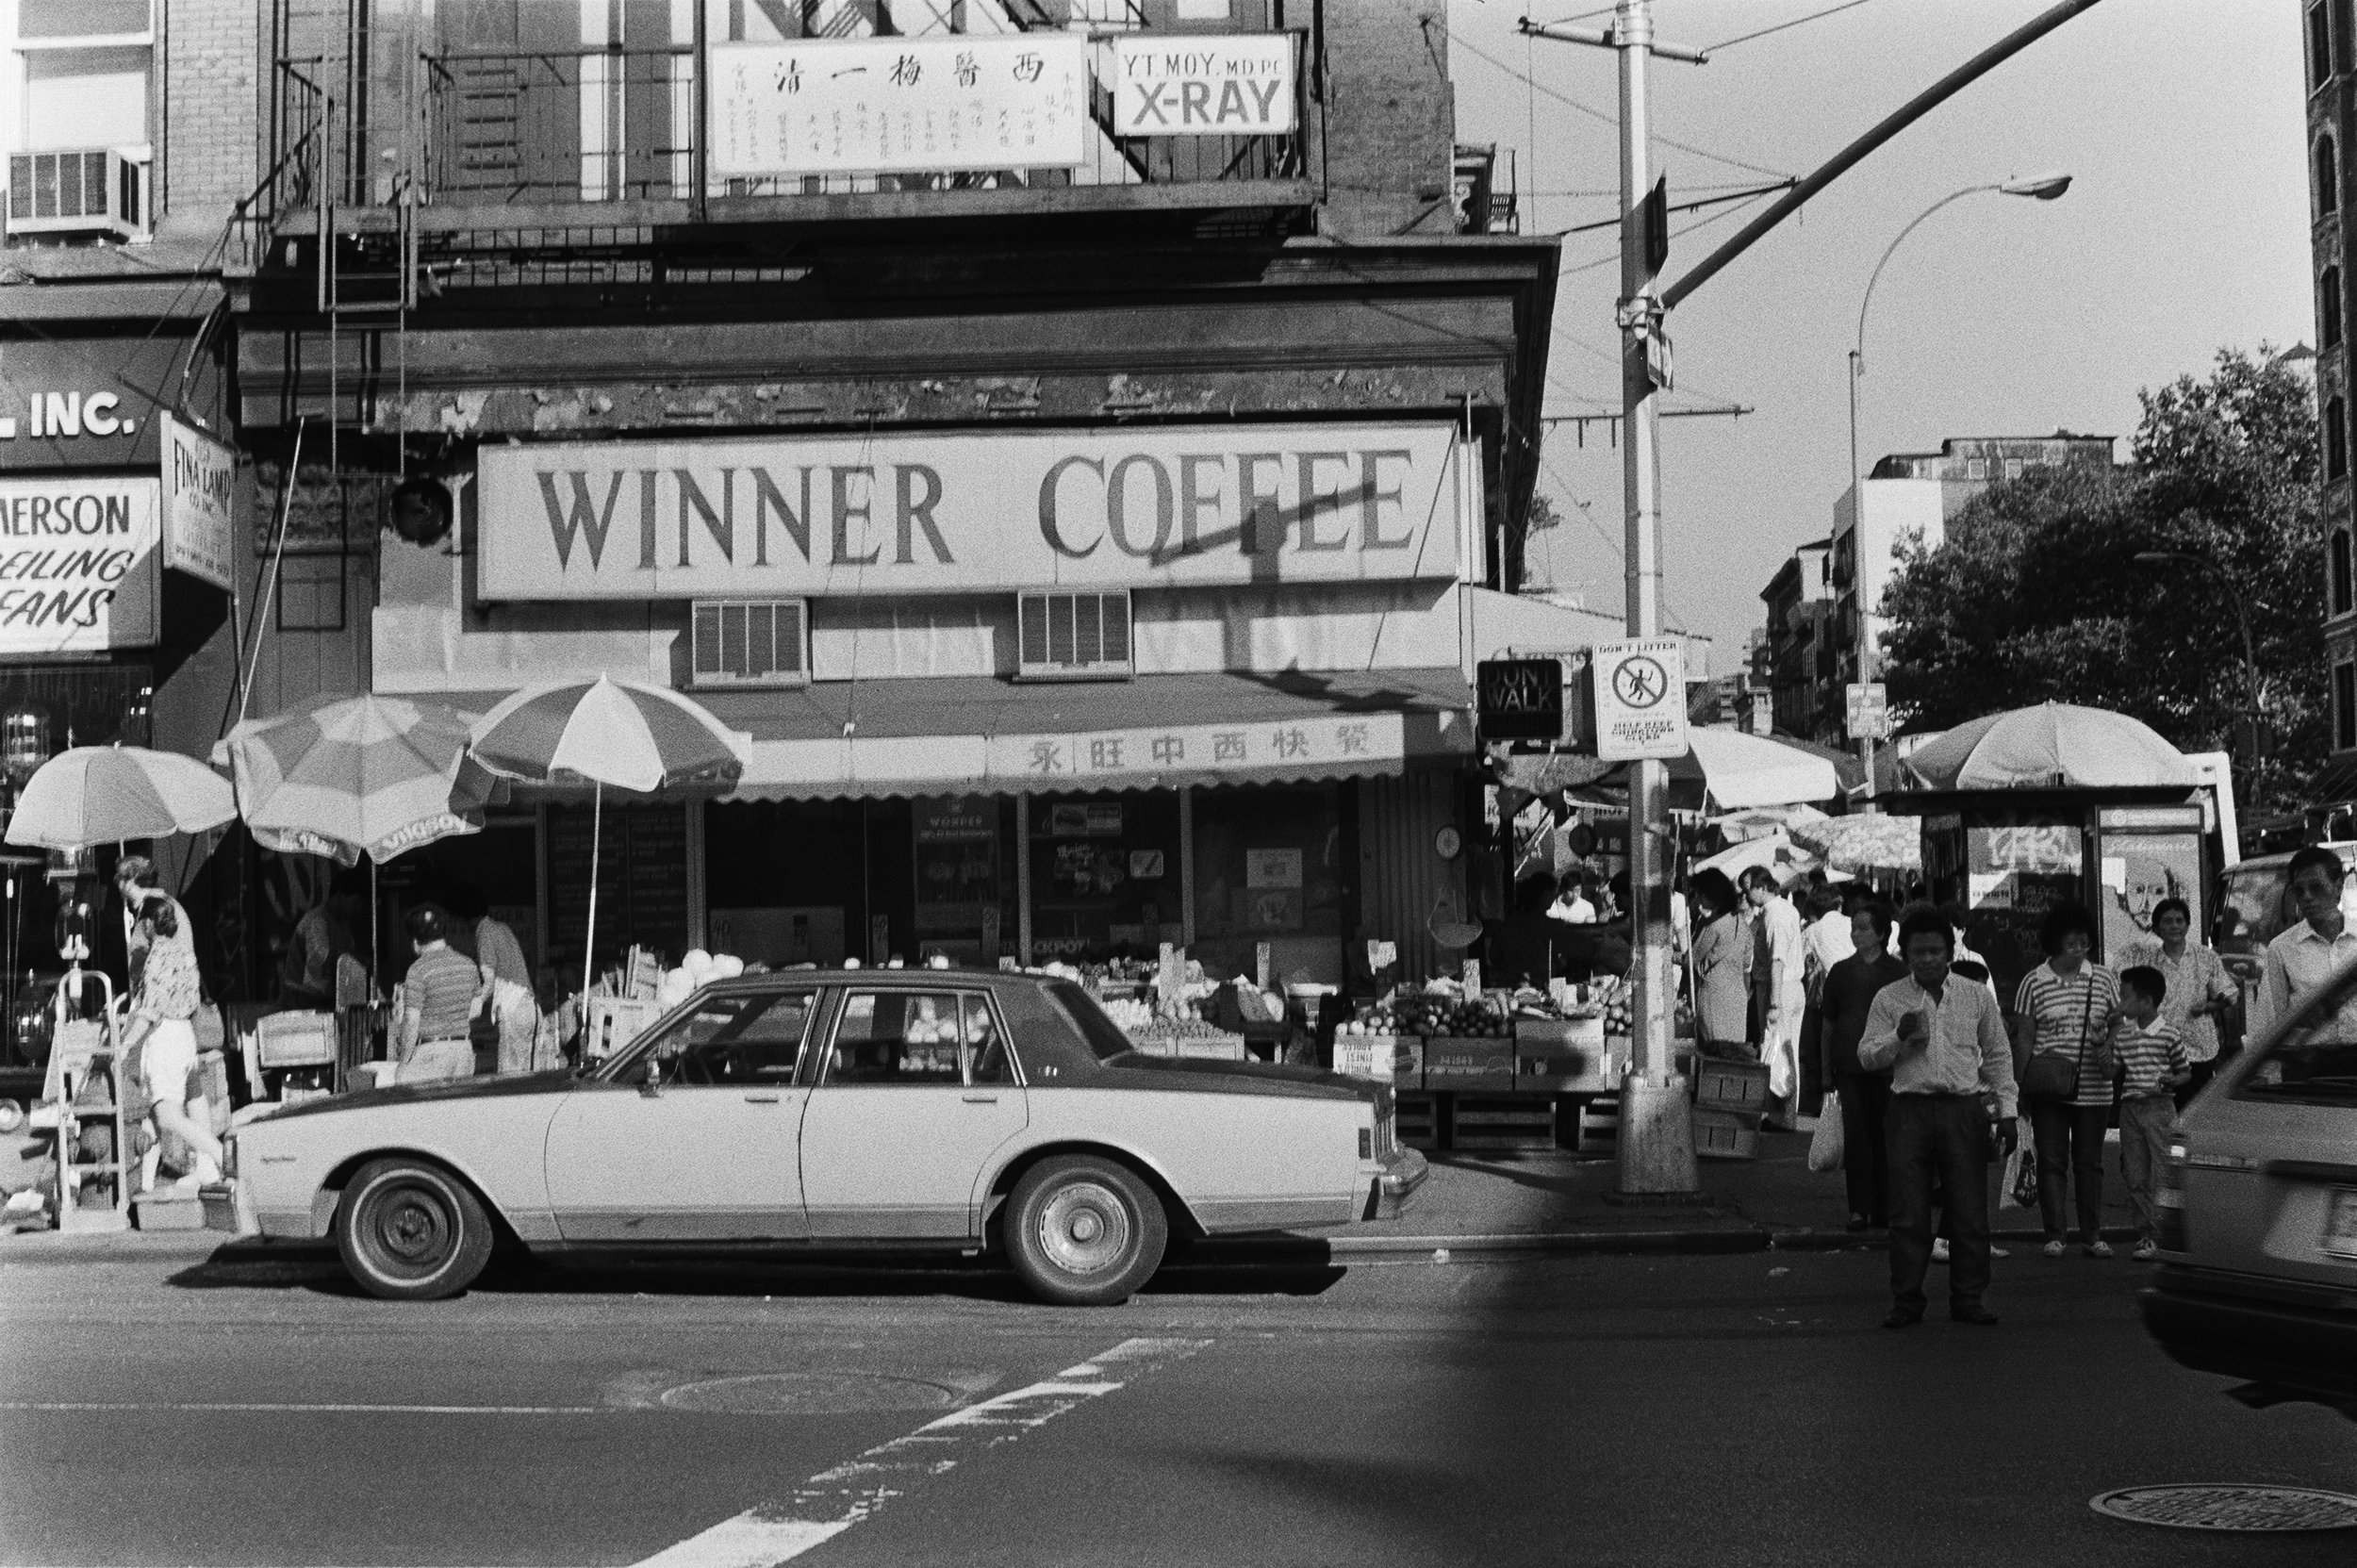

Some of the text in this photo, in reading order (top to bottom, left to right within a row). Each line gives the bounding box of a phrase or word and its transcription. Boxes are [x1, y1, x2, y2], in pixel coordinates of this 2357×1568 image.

[1132, 79, 1282, 125] X-RAY
[30, 391, 135, 437] INC.
[536, 449, 1414, 573] WINNER COFFEE
[0, 548, 135, 582] EILING
[1637, 642, 1677, 652] LITTER
[1486, 686, 1554, 712] WALK
